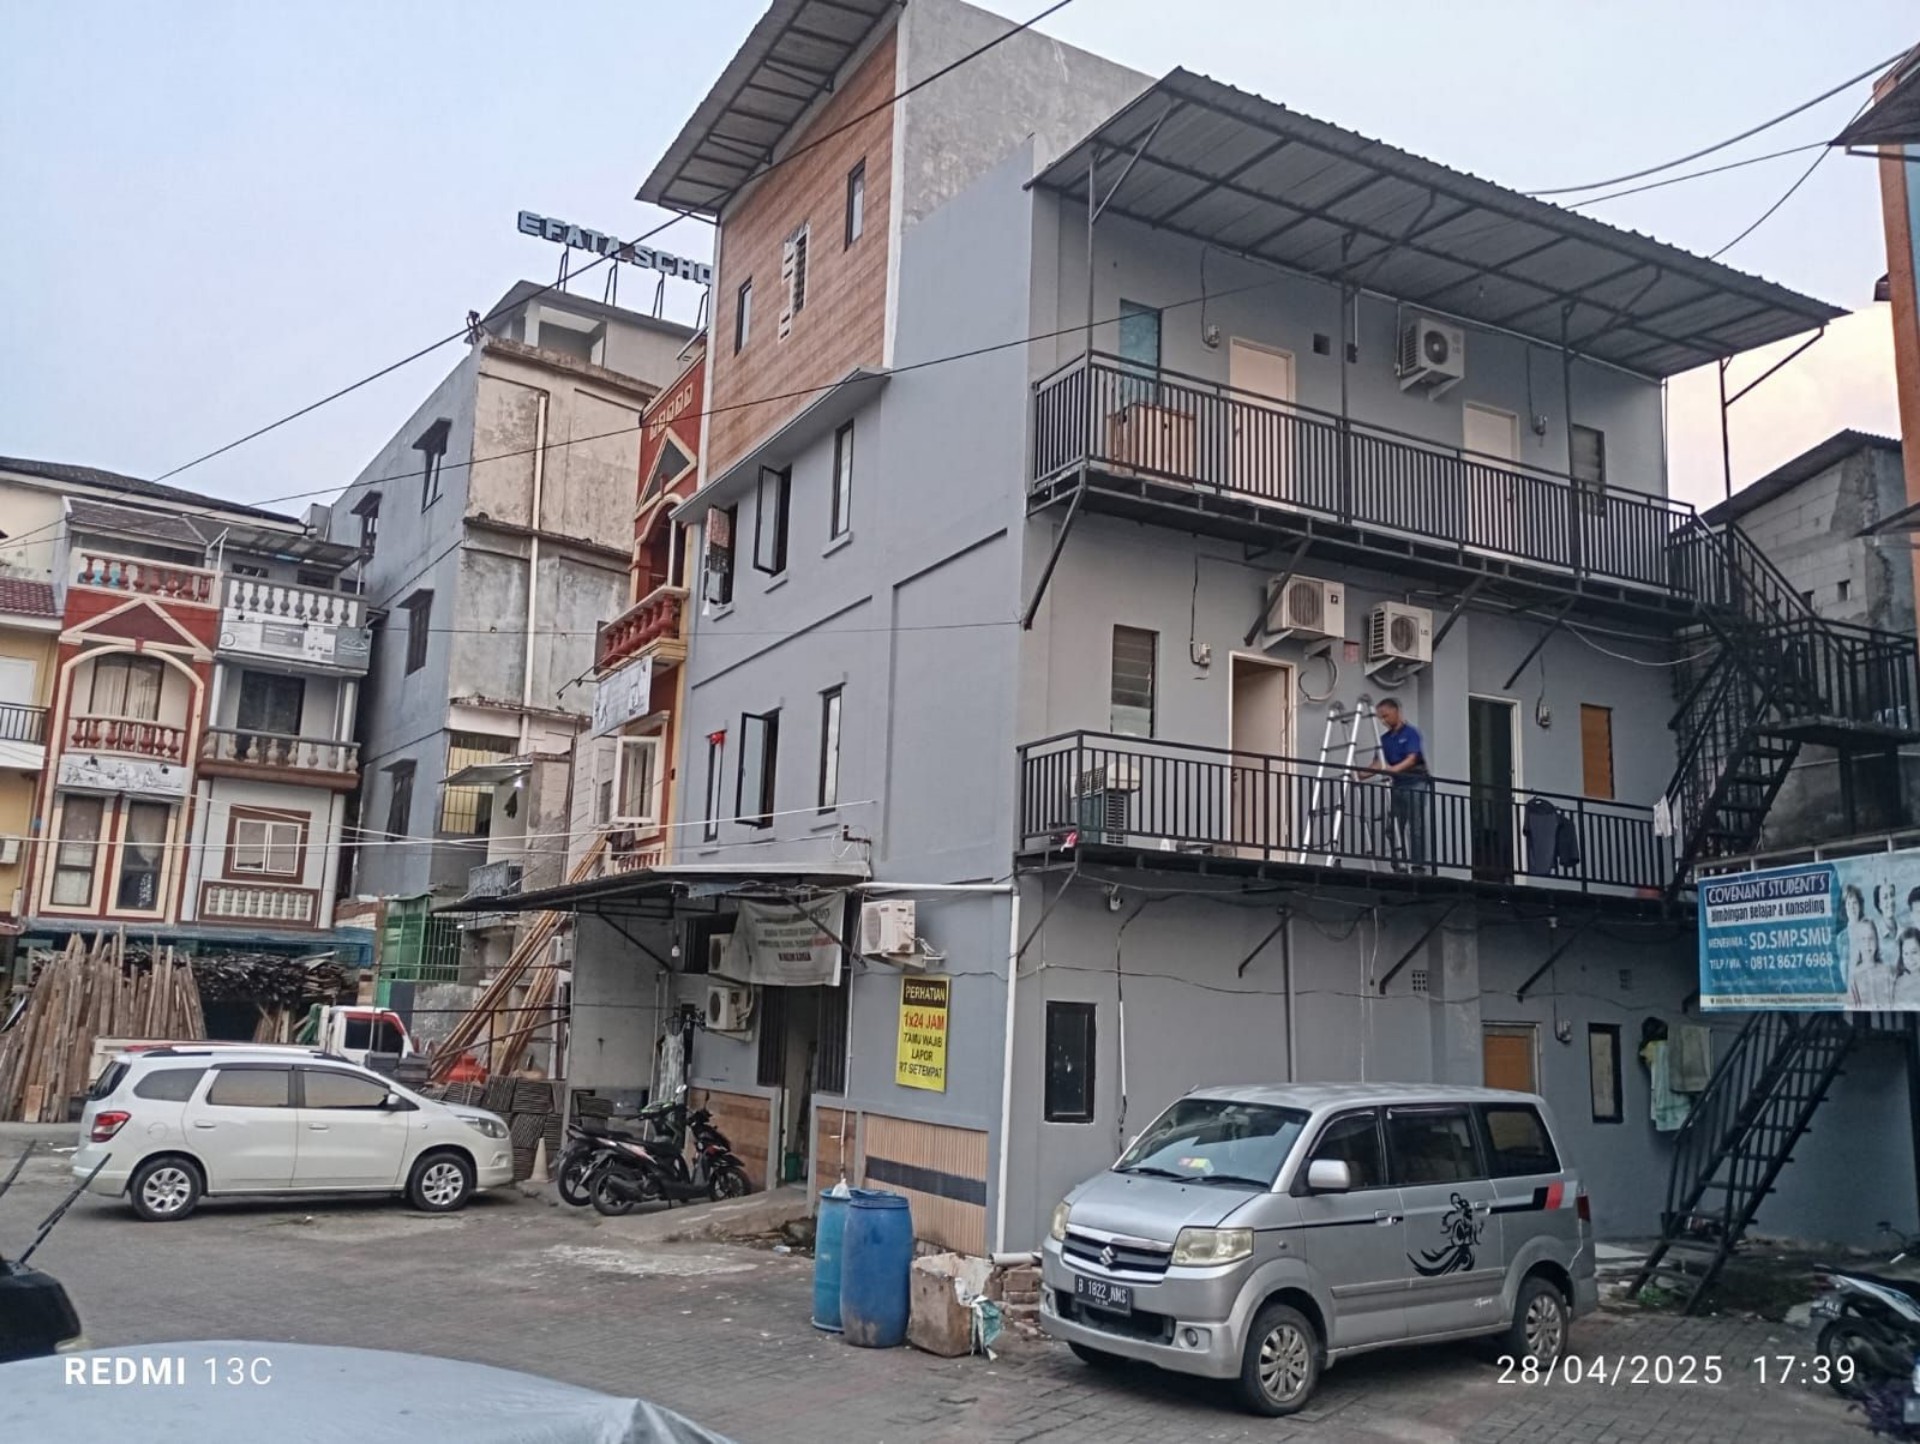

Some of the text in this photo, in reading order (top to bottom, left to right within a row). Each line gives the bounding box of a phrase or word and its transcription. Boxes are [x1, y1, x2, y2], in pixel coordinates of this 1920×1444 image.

[518, 211, 624, 261] EFATA
[1708, 874, 1826, 903] COVENANT STUDENT'S
[1750, 902, 1777, 919] Belajar
[1786, 899, 1825, 916] Konseling
[1750, 955, 1776, 970] 0812
[1777, 953, 1803, 969] 8627
[905, 986, 945, 1001] PERHATIAN
[904, 1011, 945, 1031] 1x24 JAM
[904, 1033, 943, 1048] TAMU WAJIB
[911, 1049, 934, 1061] LAPOR
[908, 1063, 943, 1079] SETEMPAT
[1078, 1278, 1084, 1293] B
[1088, 1280, 1107, 1299] 1822
